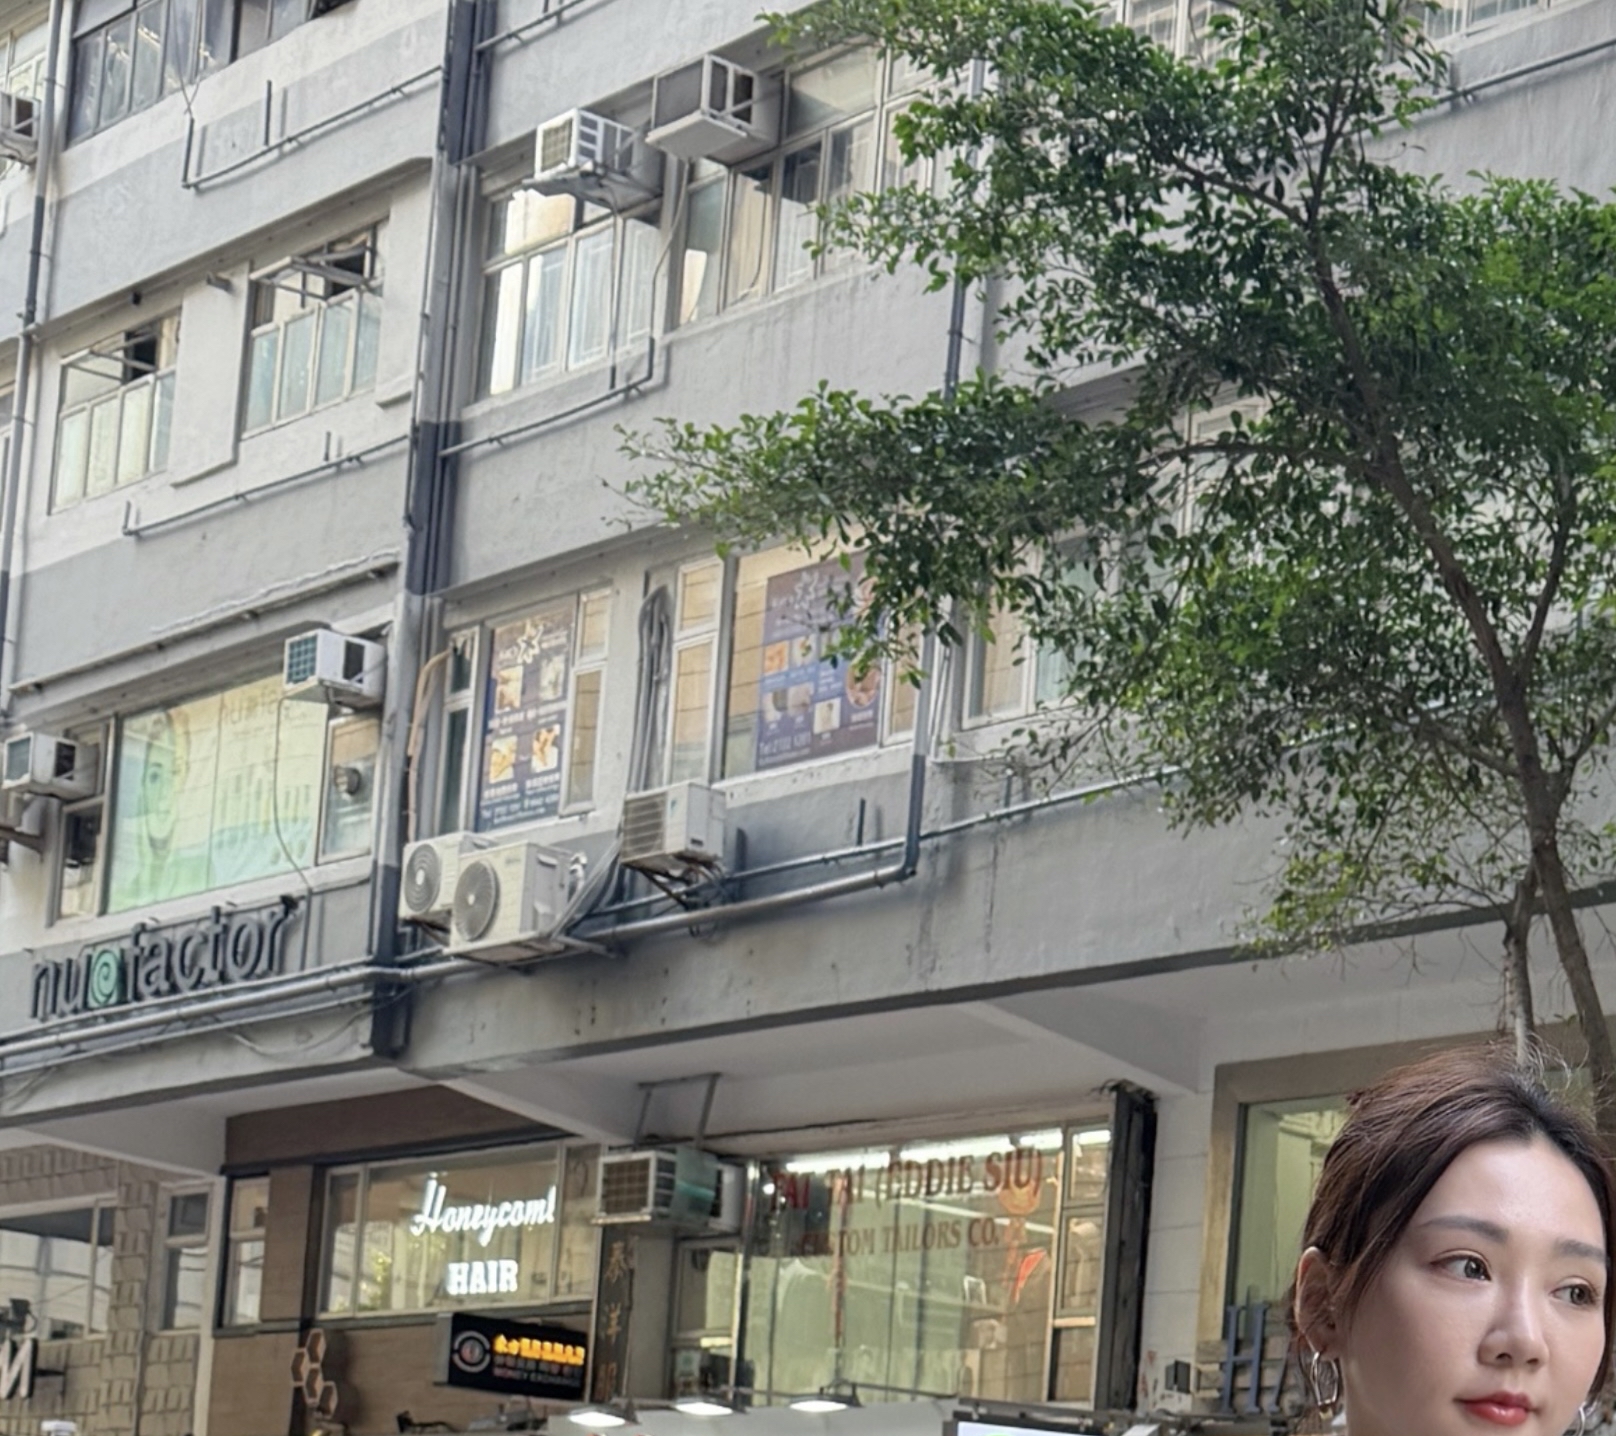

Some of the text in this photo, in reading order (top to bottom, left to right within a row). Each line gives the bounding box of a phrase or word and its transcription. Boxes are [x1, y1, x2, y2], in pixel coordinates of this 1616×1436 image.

[985, 1147, 1043, 1200] SIU)
[884, 1220, 961, 1252] TAILORS
[447, 1258, 519, 1295] HAIR
